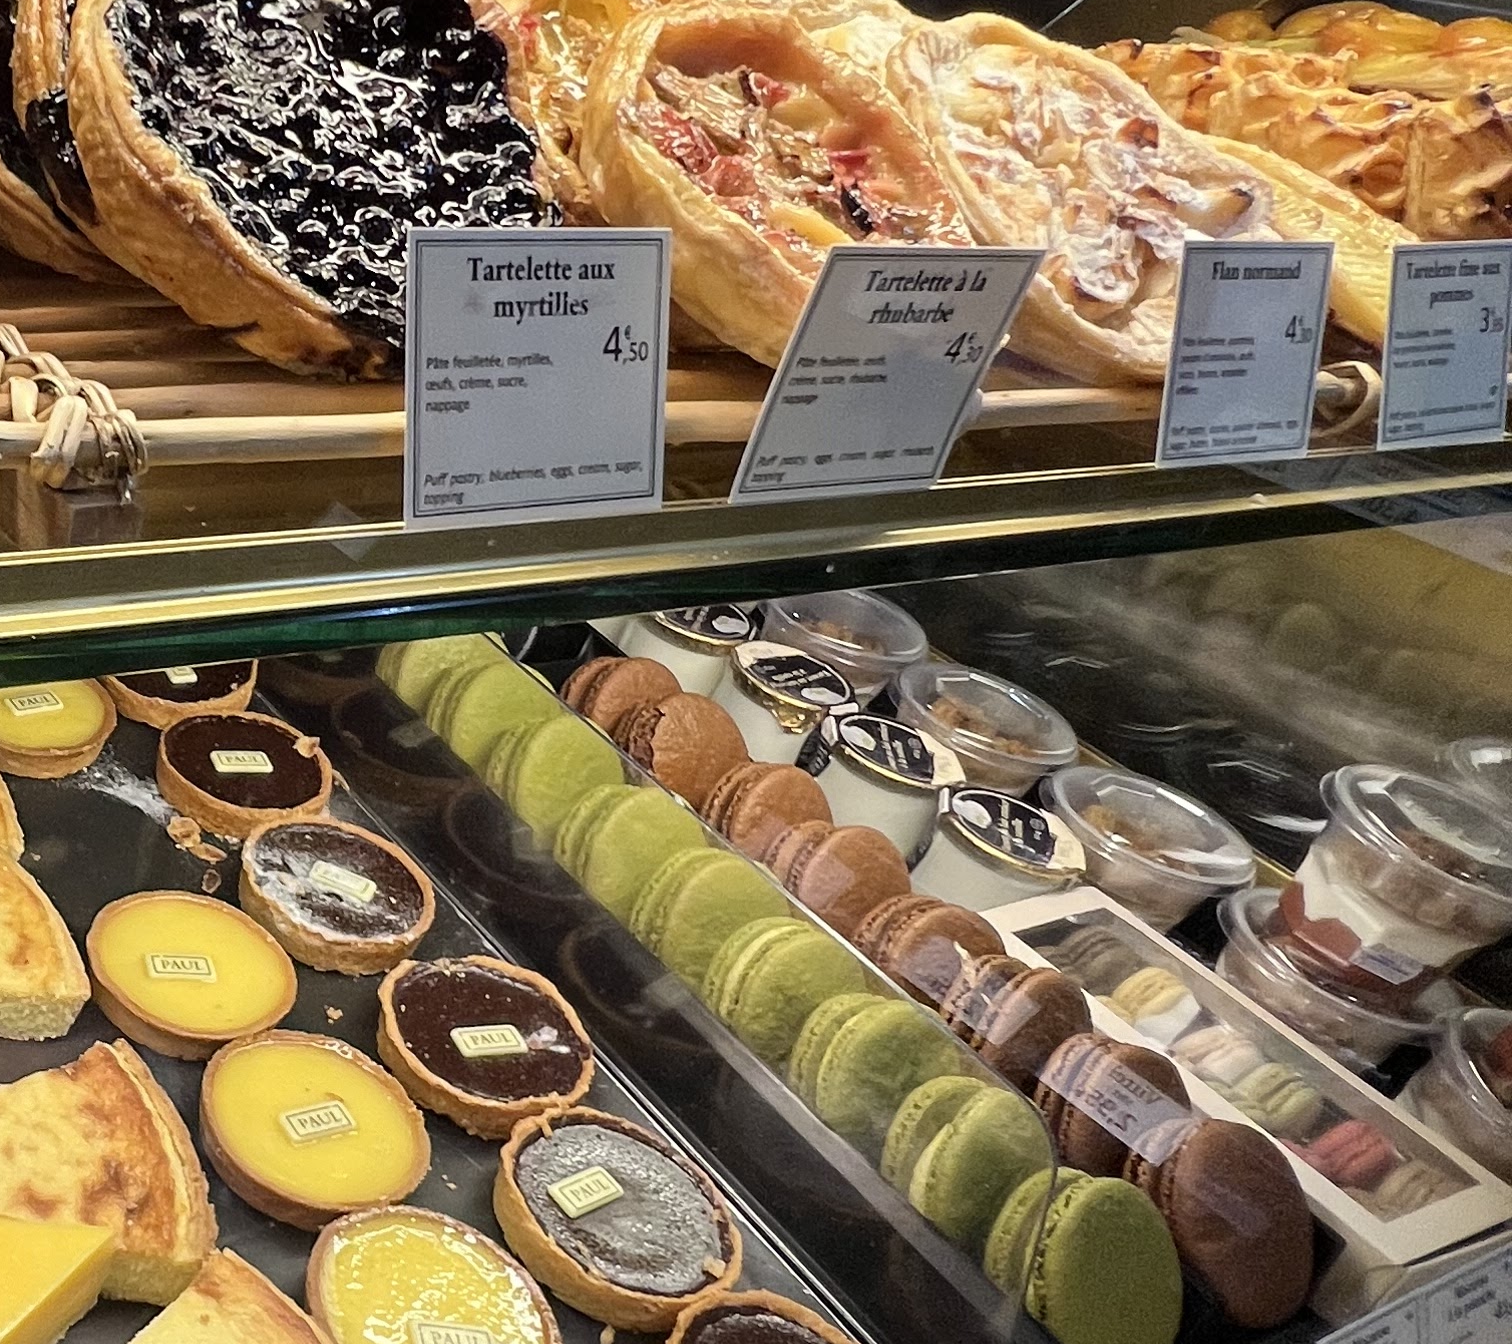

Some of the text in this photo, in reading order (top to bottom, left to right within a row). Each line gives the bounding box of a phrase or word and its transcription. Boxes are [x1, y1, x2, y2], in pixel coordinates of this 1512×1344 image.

[467, 257, 616, 282] Tartelette aux
[1211, 261, 1301, 280] Flan normand
[864, 270, 986, 292] Tartelette à la
[493, 292, 589, 325] myrtilles
[868, 302, 954, 324] rhubarbe
[498, 377, 528, 387] sucre,
[18, 695, 53, 710] PAUL
[160, 959, 204, 972] PAUL
[469, 1033, 512, 1045] PAUL
[297, 1112, 342, 1130] PAUL
[571, 1176, 609, 1201] PAUL
